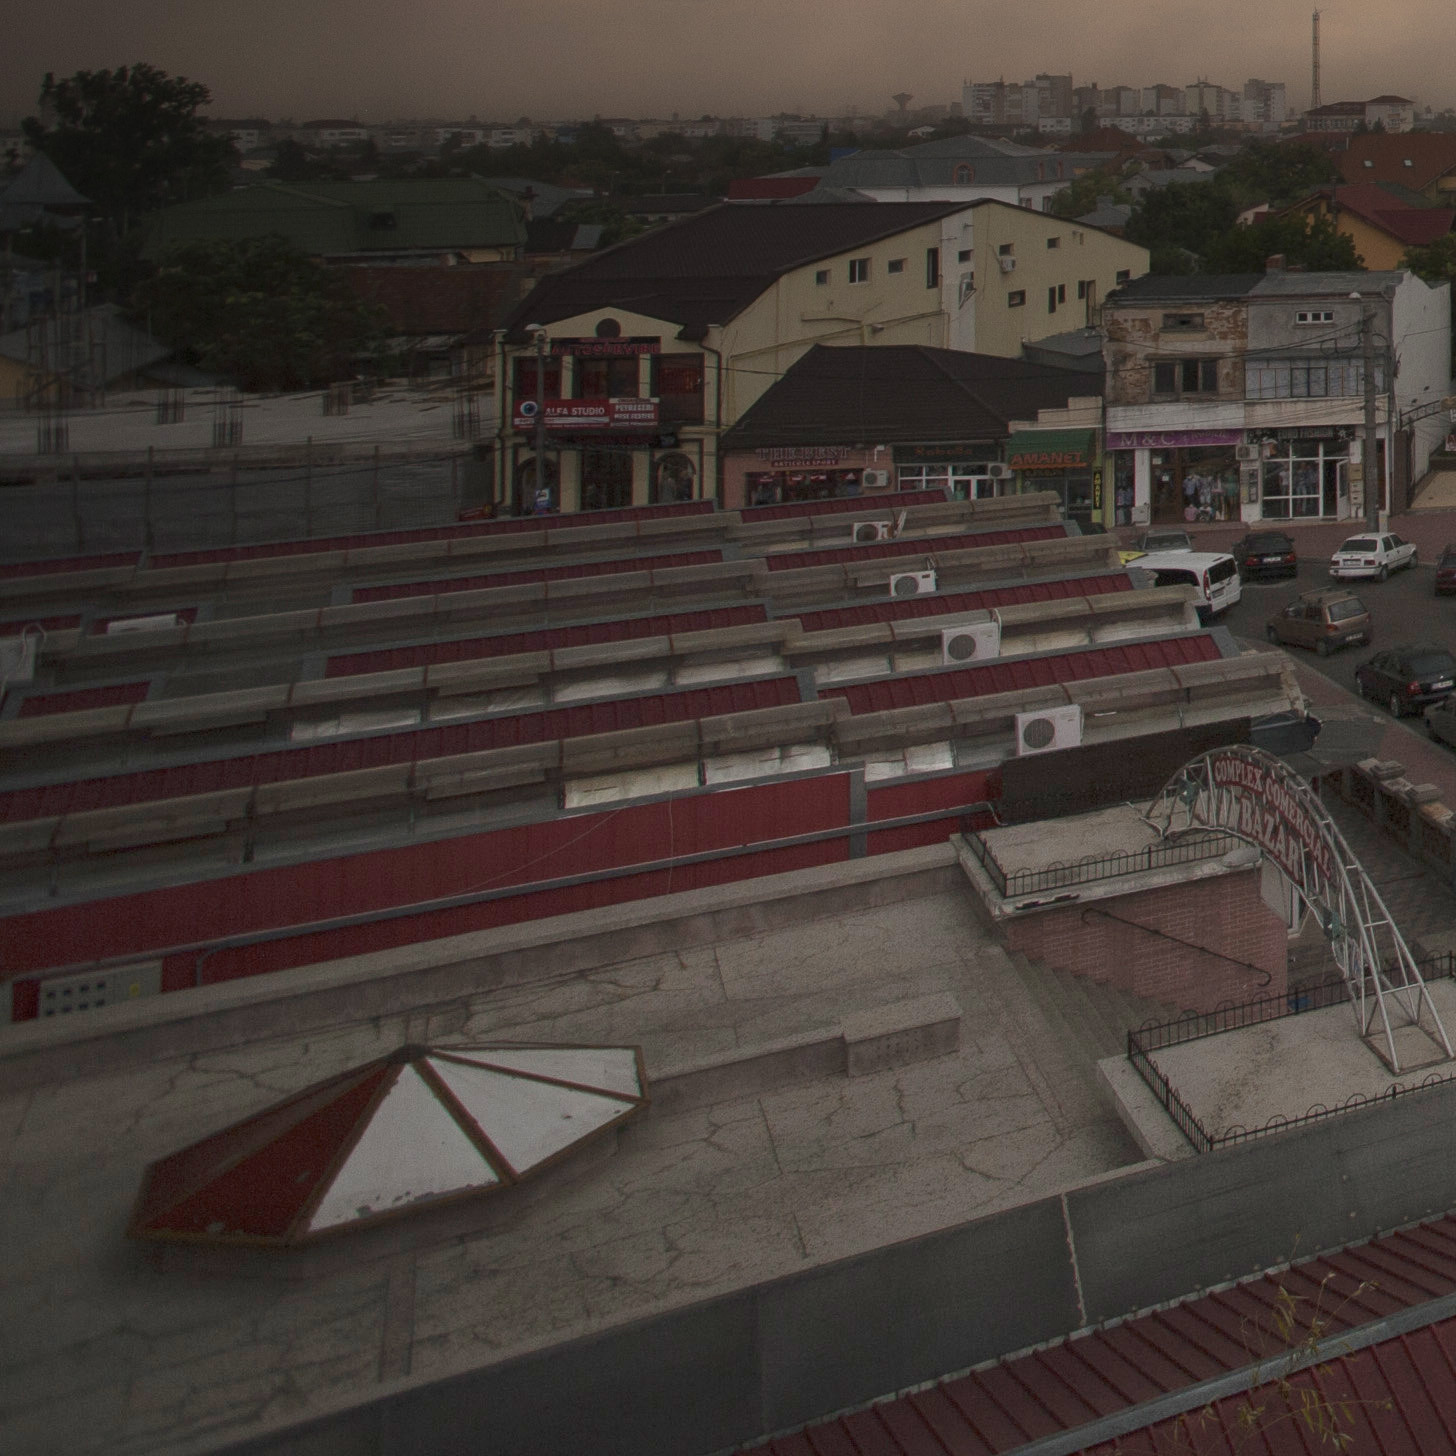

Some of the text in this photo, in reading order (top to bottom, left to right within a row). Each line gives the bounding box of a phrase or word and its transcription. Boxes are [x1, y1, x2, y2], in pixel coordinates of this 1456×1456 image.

[545, 406, 605, 416] ALFA STUDIO
[1120, 433, 1137, 446] M
[1142, 434, 1156, 446] &
[1160, 432, 1175, 446] C
[1010, 451, 1083, 465] AMANET
[1214, 760, 1331, 879] COMPLEX COMERCIAL
[1240, 797, 1299, 881] BAZAR
